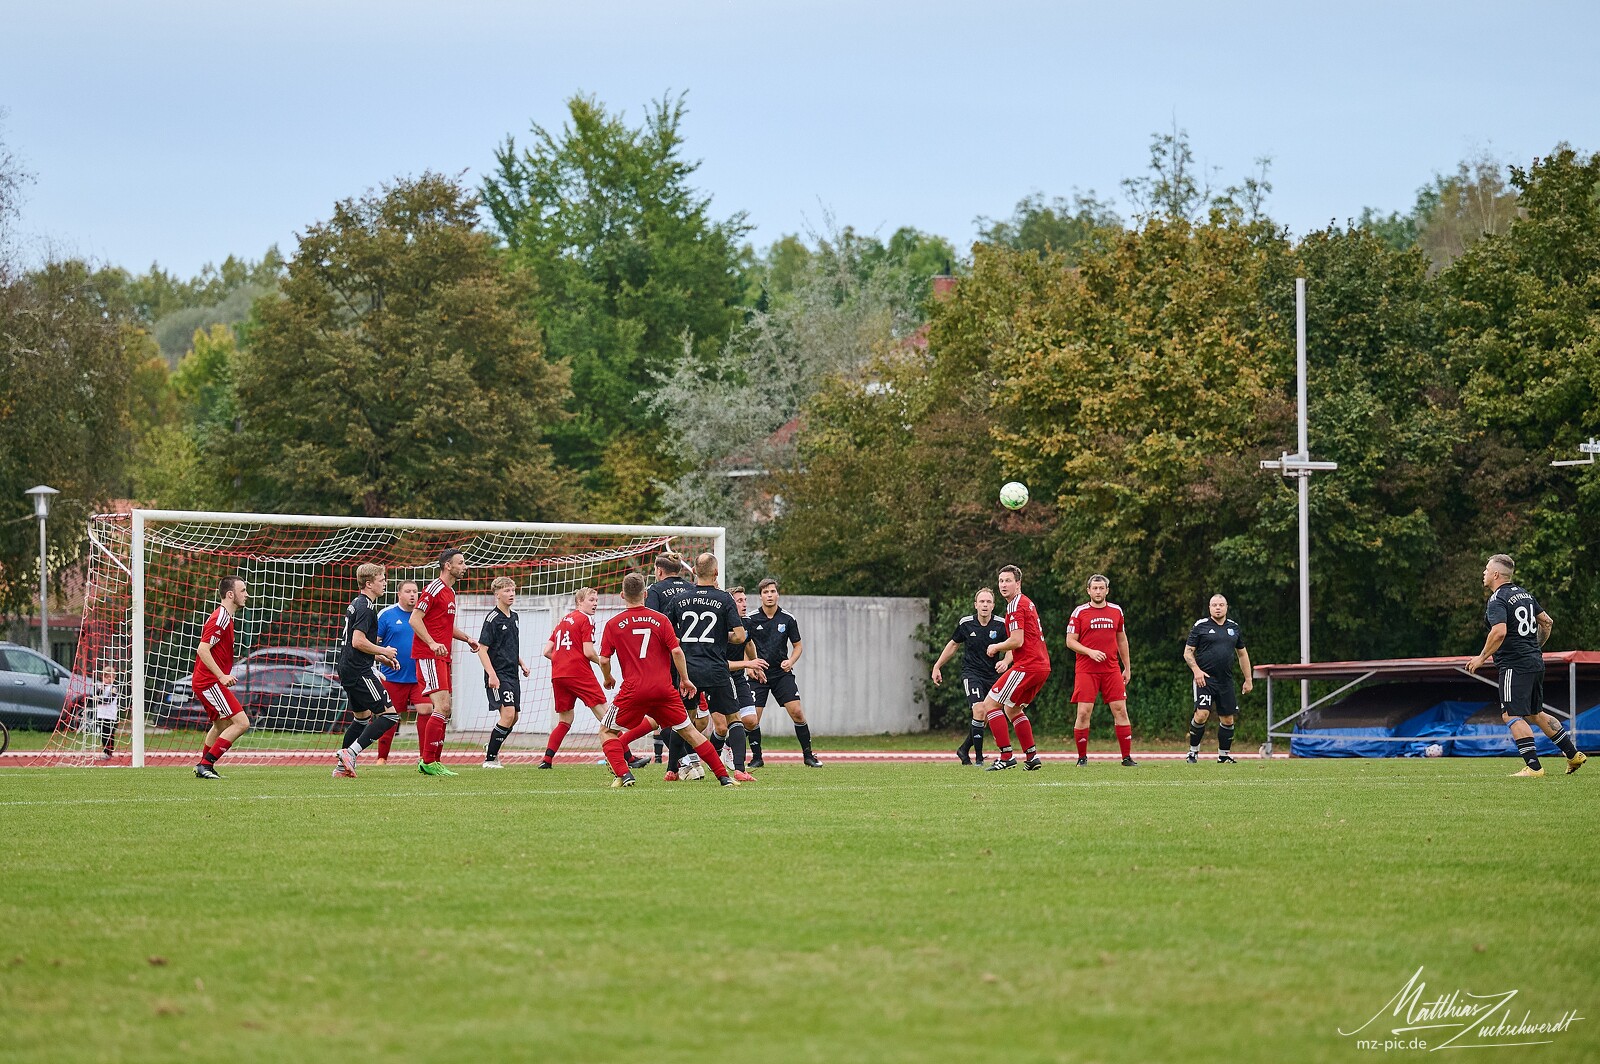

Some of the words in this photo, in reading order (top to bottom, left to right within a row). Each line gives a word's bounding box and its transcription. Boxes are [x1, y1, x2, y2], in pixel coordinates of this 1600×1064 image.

[662, 587, 675, 597] TSV
[678, 597, 691, 608] TSV
[692, 597, 723, 609] PALLING
[618, 617, 629, 629] SV
[632, 616, 661, 628] Laufen
[1514, 603, 1537, 636] 86
[681, 610, 717, 643] 22
[555, 629, 573, 651] 14
[632, 628, 651, 659] 7
[971, 687, 981, 699] 4
[1199, 694, 1212, 706] 24
